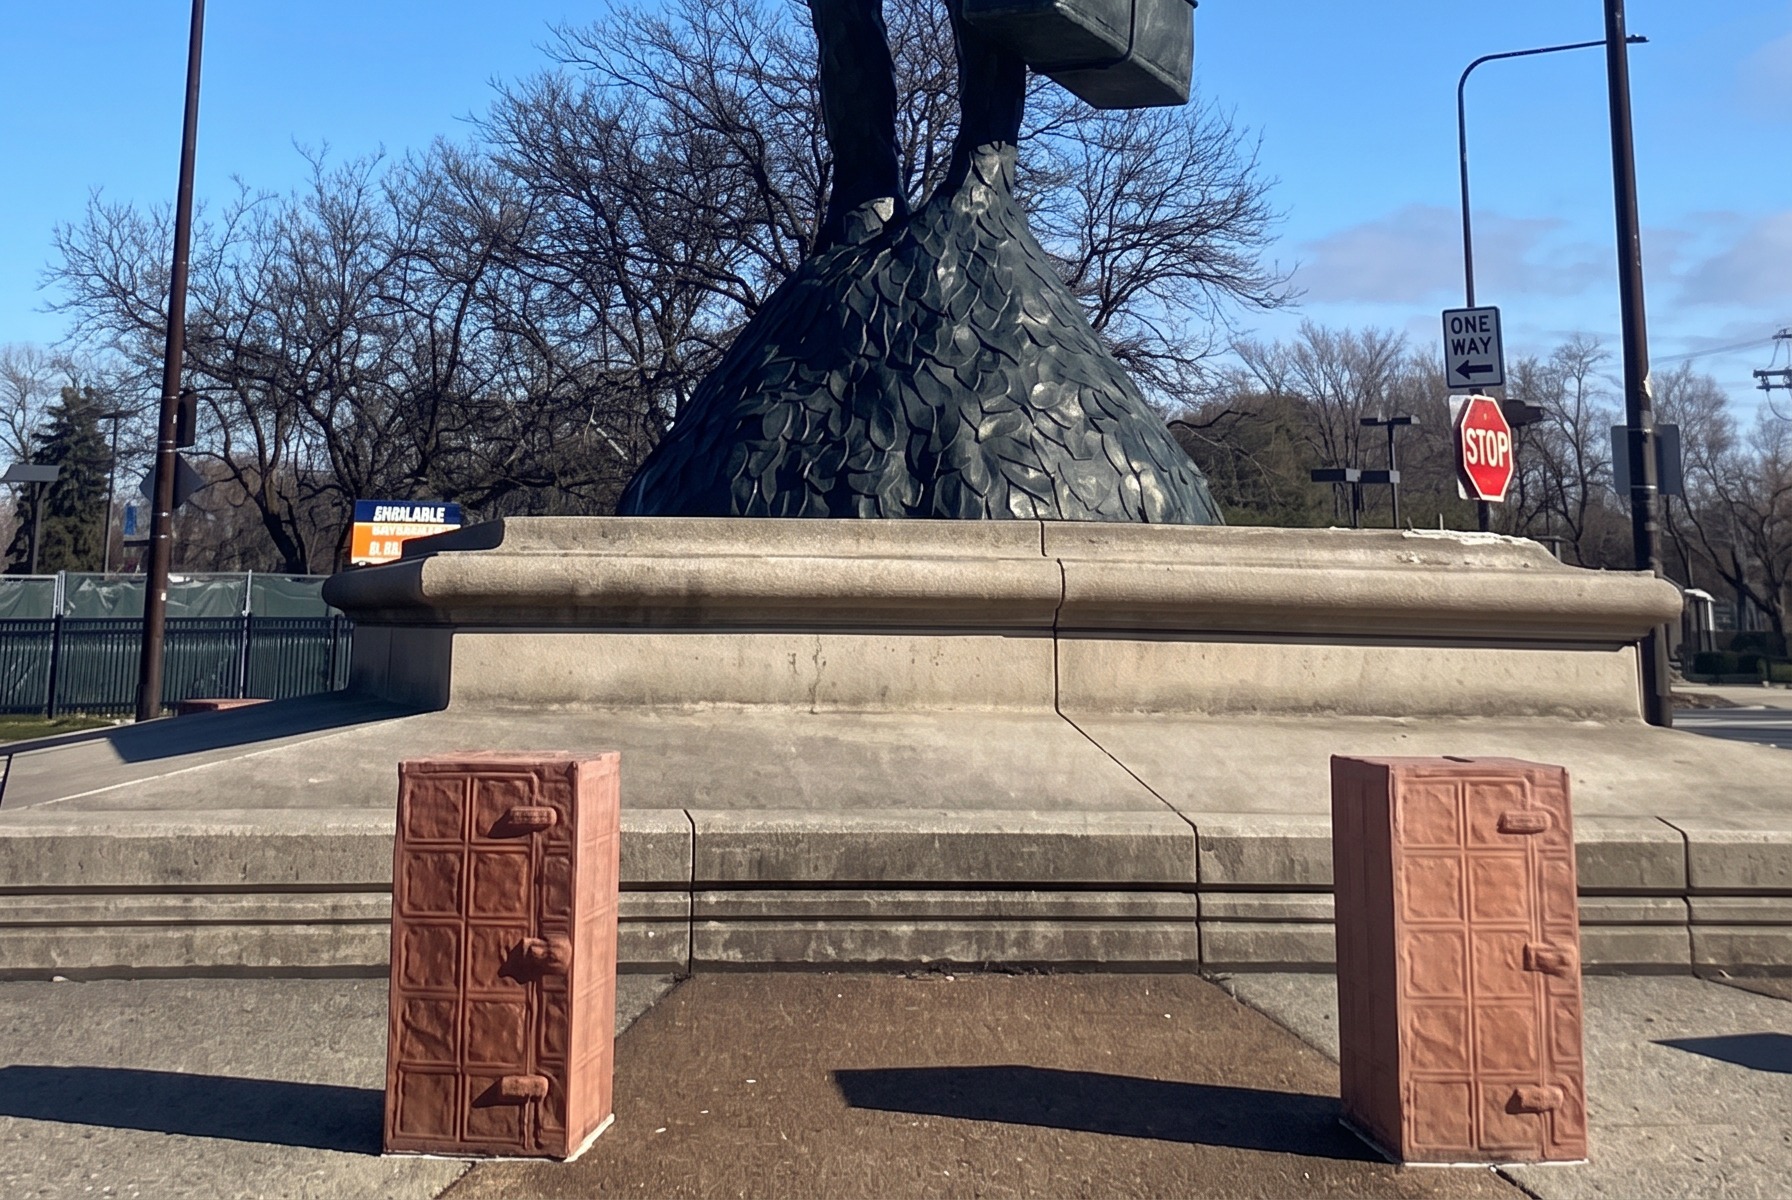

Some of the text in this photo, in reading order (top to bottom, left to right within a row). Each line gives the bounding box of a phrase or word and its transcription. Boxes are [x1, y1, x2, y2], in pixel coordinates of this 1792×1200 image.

[1451, 315, 1490, 334] ONE
[1451, 336, 1492, 356] WAY
[1466, 427, 1509, 468] STOP
